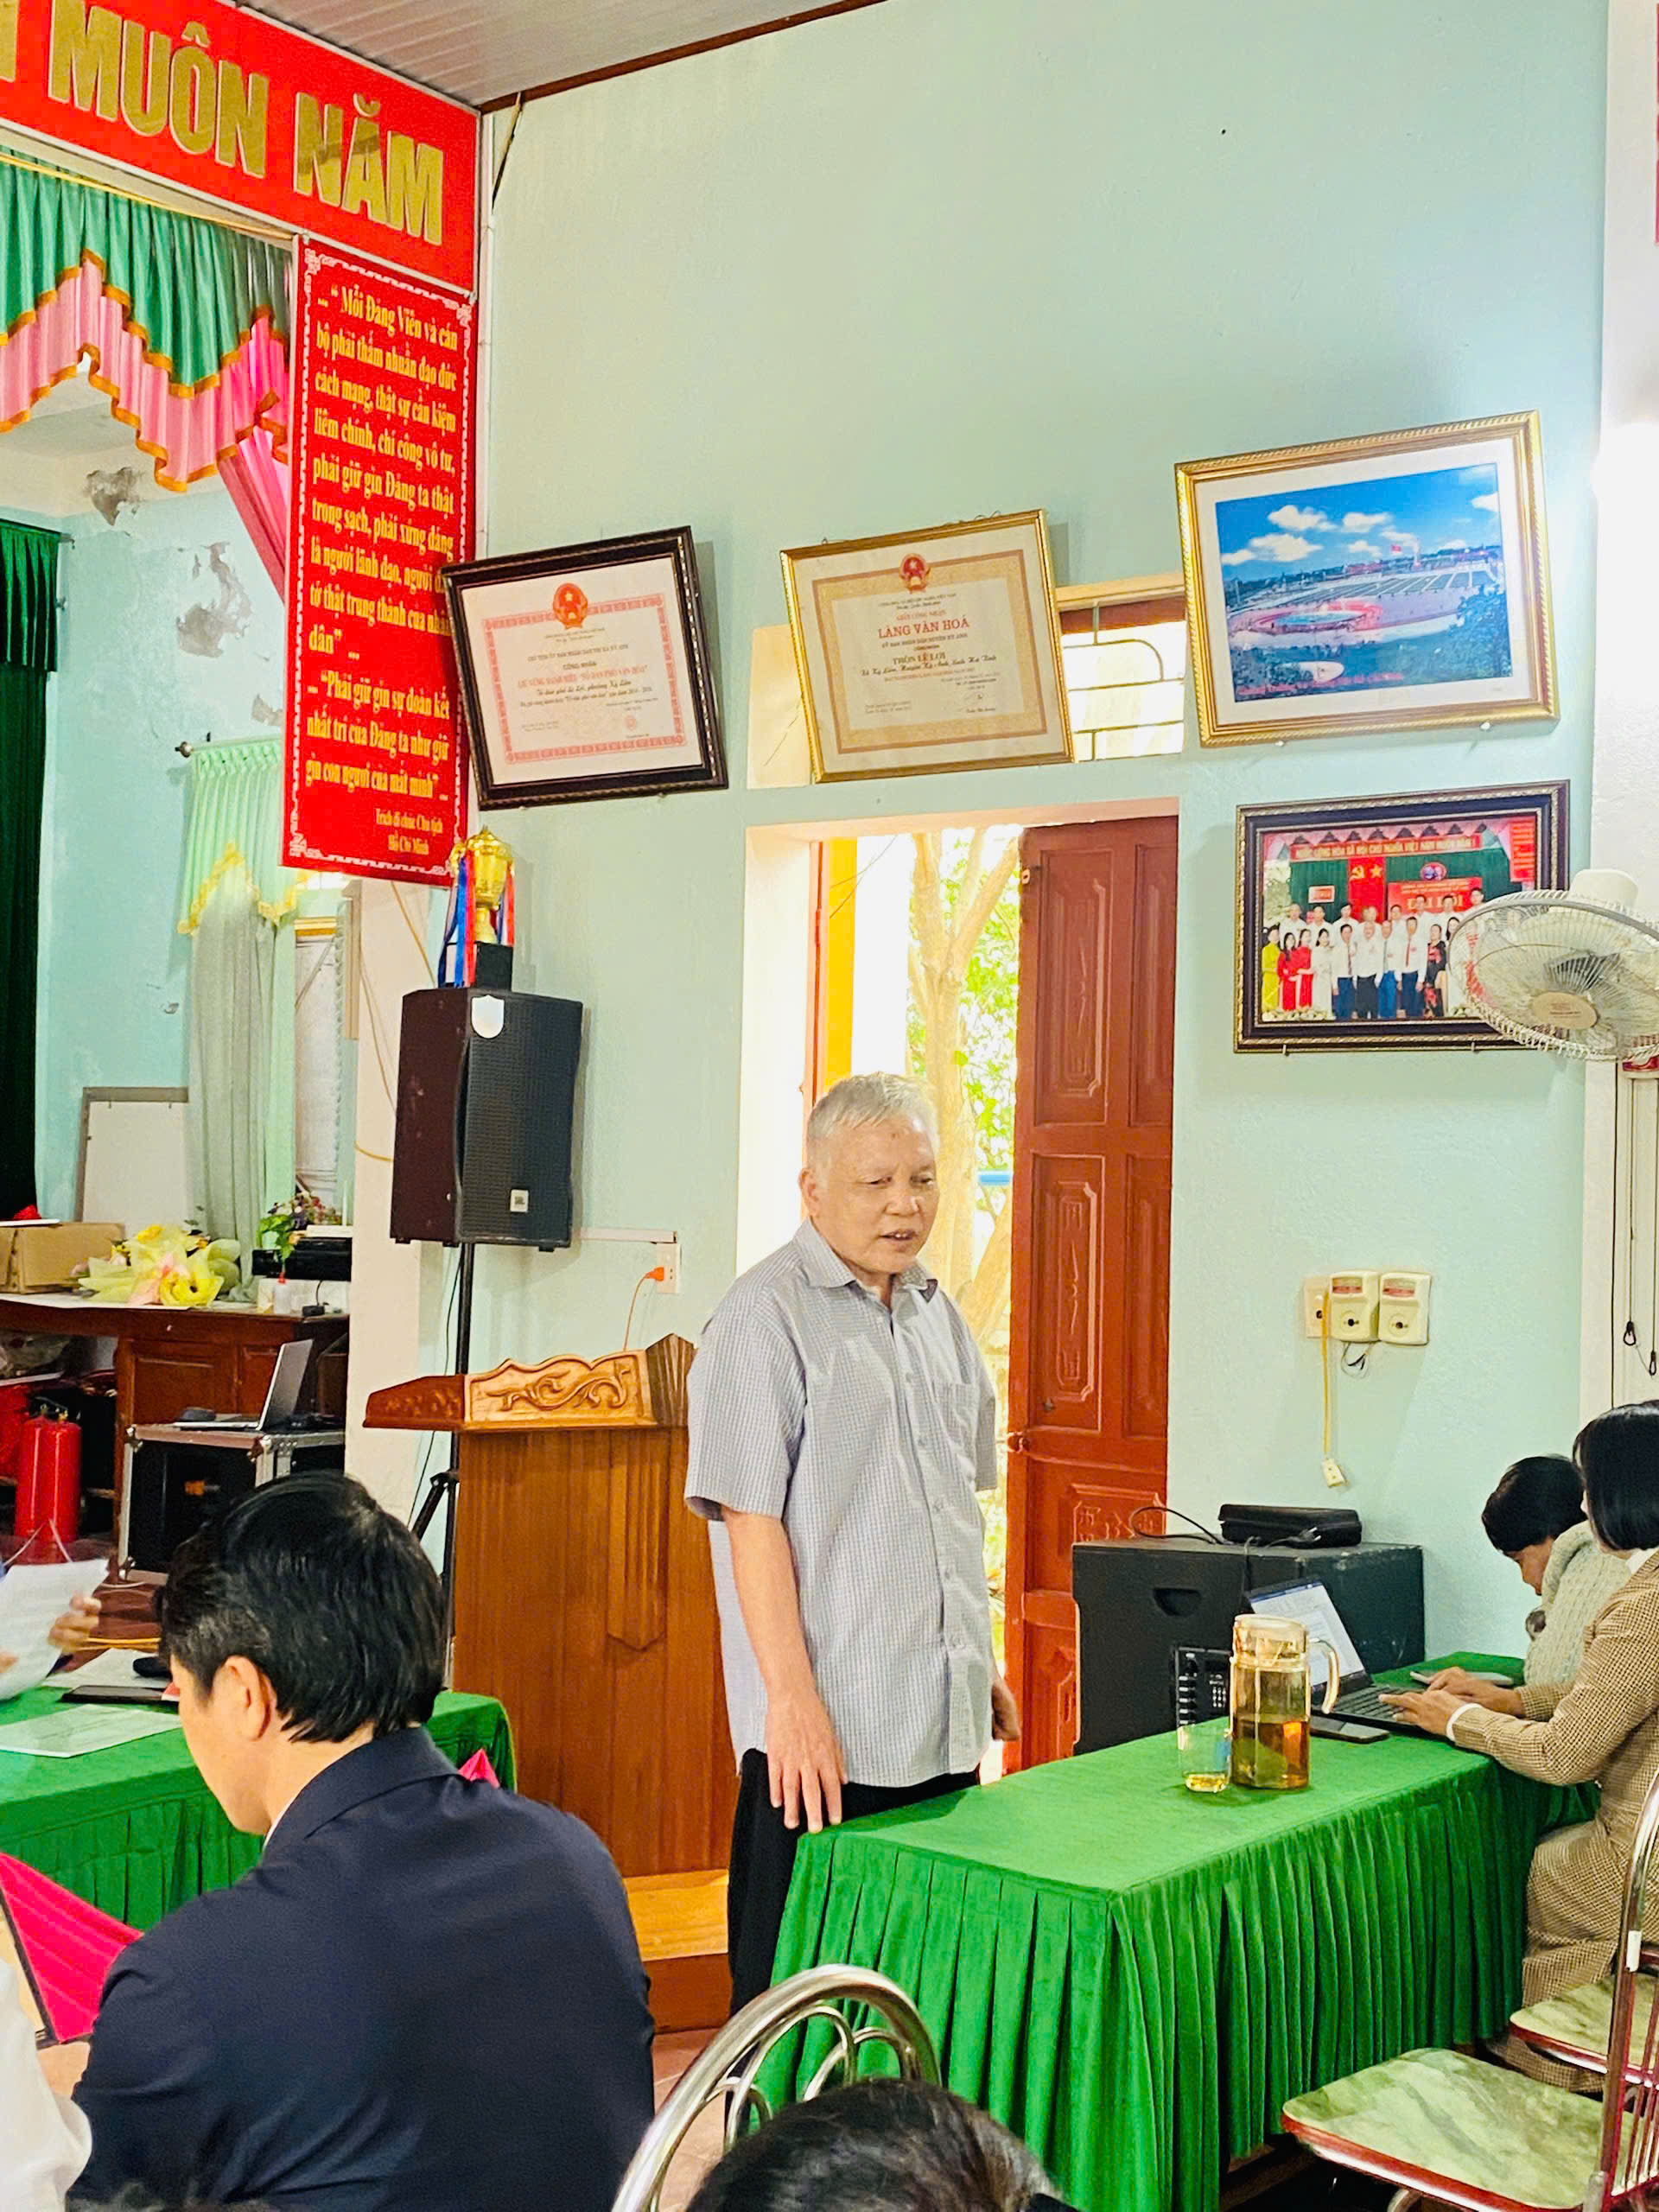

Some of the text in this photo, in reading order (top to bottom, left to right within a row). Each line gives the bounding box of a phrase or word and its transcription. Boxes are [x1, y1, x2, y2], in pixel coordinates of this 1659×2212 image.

[48, 0, 269, 179] MUÔN
[293, 92, 443, 246] NĂM
[365, 295, 396, 337] Đảng
[424, 317, 436, 344] và
[439, 322, 458, 351] cán
[317, 320, 330, 358] bộ
[332, 327, 355, 361] phải
[418, 356, 436, 390] đạo
[315, 366, 340, 397] cách
[376, 384, 397, 421] thật
[398, 397, 411, 426] sự
[412, 388, 429, 424] cần
[314, 408, 339, 440] liêm
[378, 429, 397, 456] chí
[397, 433, 423, 472] công
[425, 442, 438, 469] vô
[313, 452, 454, 520] phải giữ gìn Đảng ta thật
[311, 535, 321, 565] là
[323, 543, 353, 575] người
[355, 547, 378, 578] lãnh
[312, 498, 342, 534] trong
[373, 512, 397, 543] phải
[400, 518, 426, 556] xứng
[428, 525, 454, 562] đáng
[310, 581, 322, 607] tớ
[324, 583, 345, 619] thật
[346, 592, 375, 626] trung
[377, 595, 406, 626] thành
[353, 677, 372, 710] giữ
[373, 680, 390, 714] gìn
[406, 686, 432, 716] đoàn
[307, 704, 332, 739] nhất
[370, 721, 397, 759] Đảng
[398, 730, 409, 753] ta
[410, 729, 431, 757] như
[432, 733, 449, 766] giữ
[323, 762, 340, 784] con
